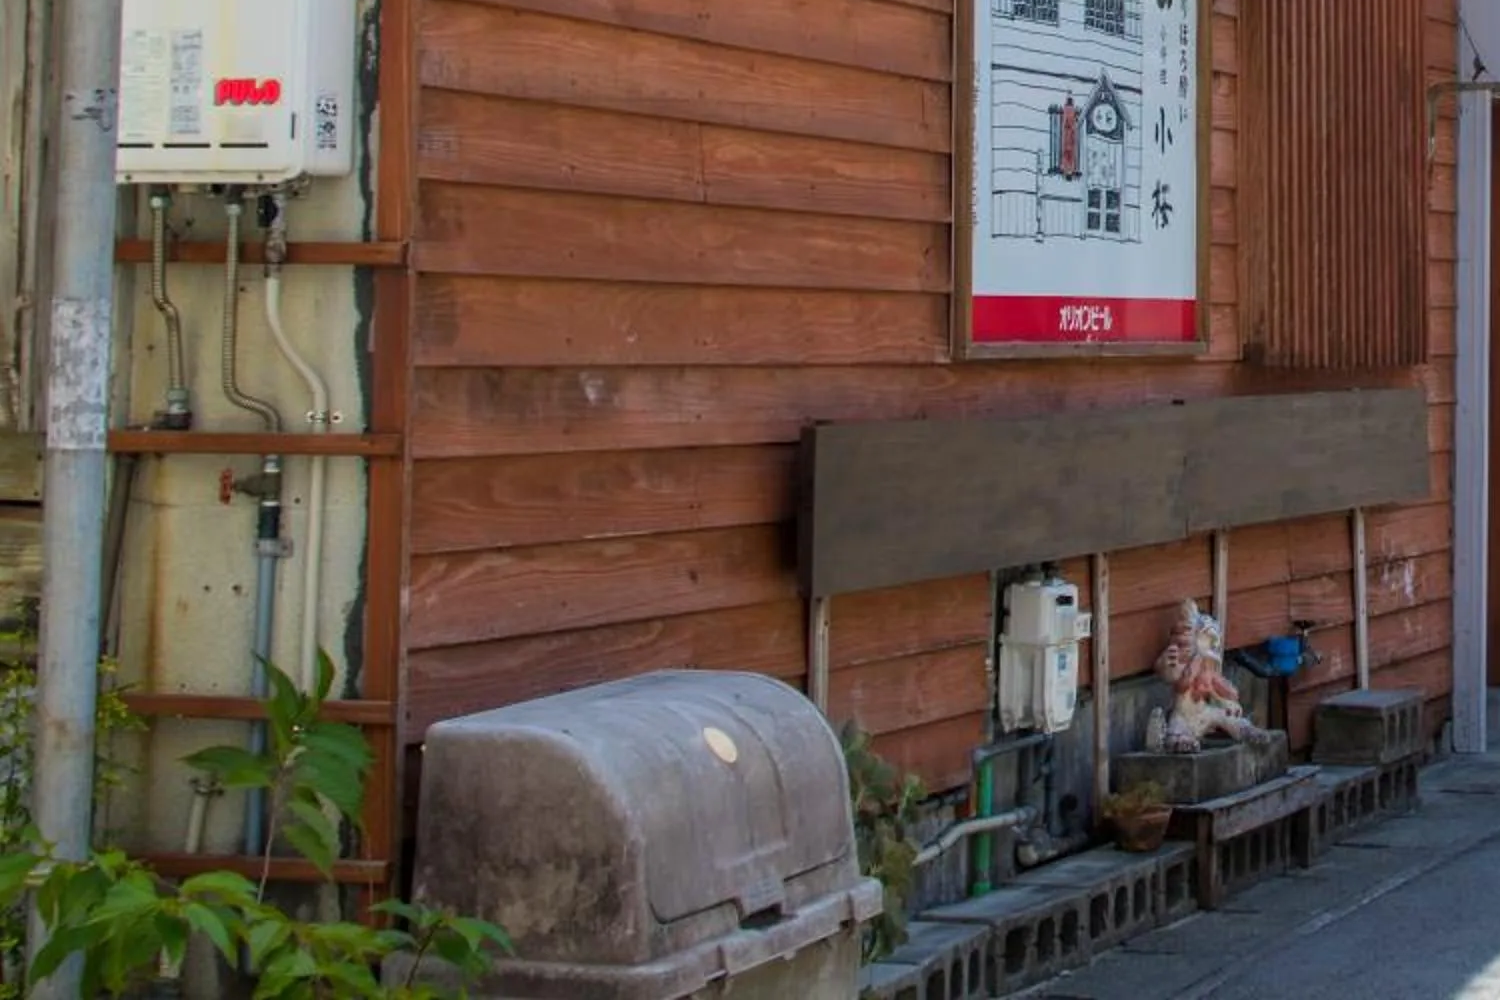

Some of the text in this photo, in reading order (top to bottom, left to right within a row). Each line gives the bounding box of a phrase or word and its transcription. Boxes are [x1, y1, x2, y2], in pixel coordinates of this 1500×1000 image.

[1059, 304, 1113, 331] オリオンビール
